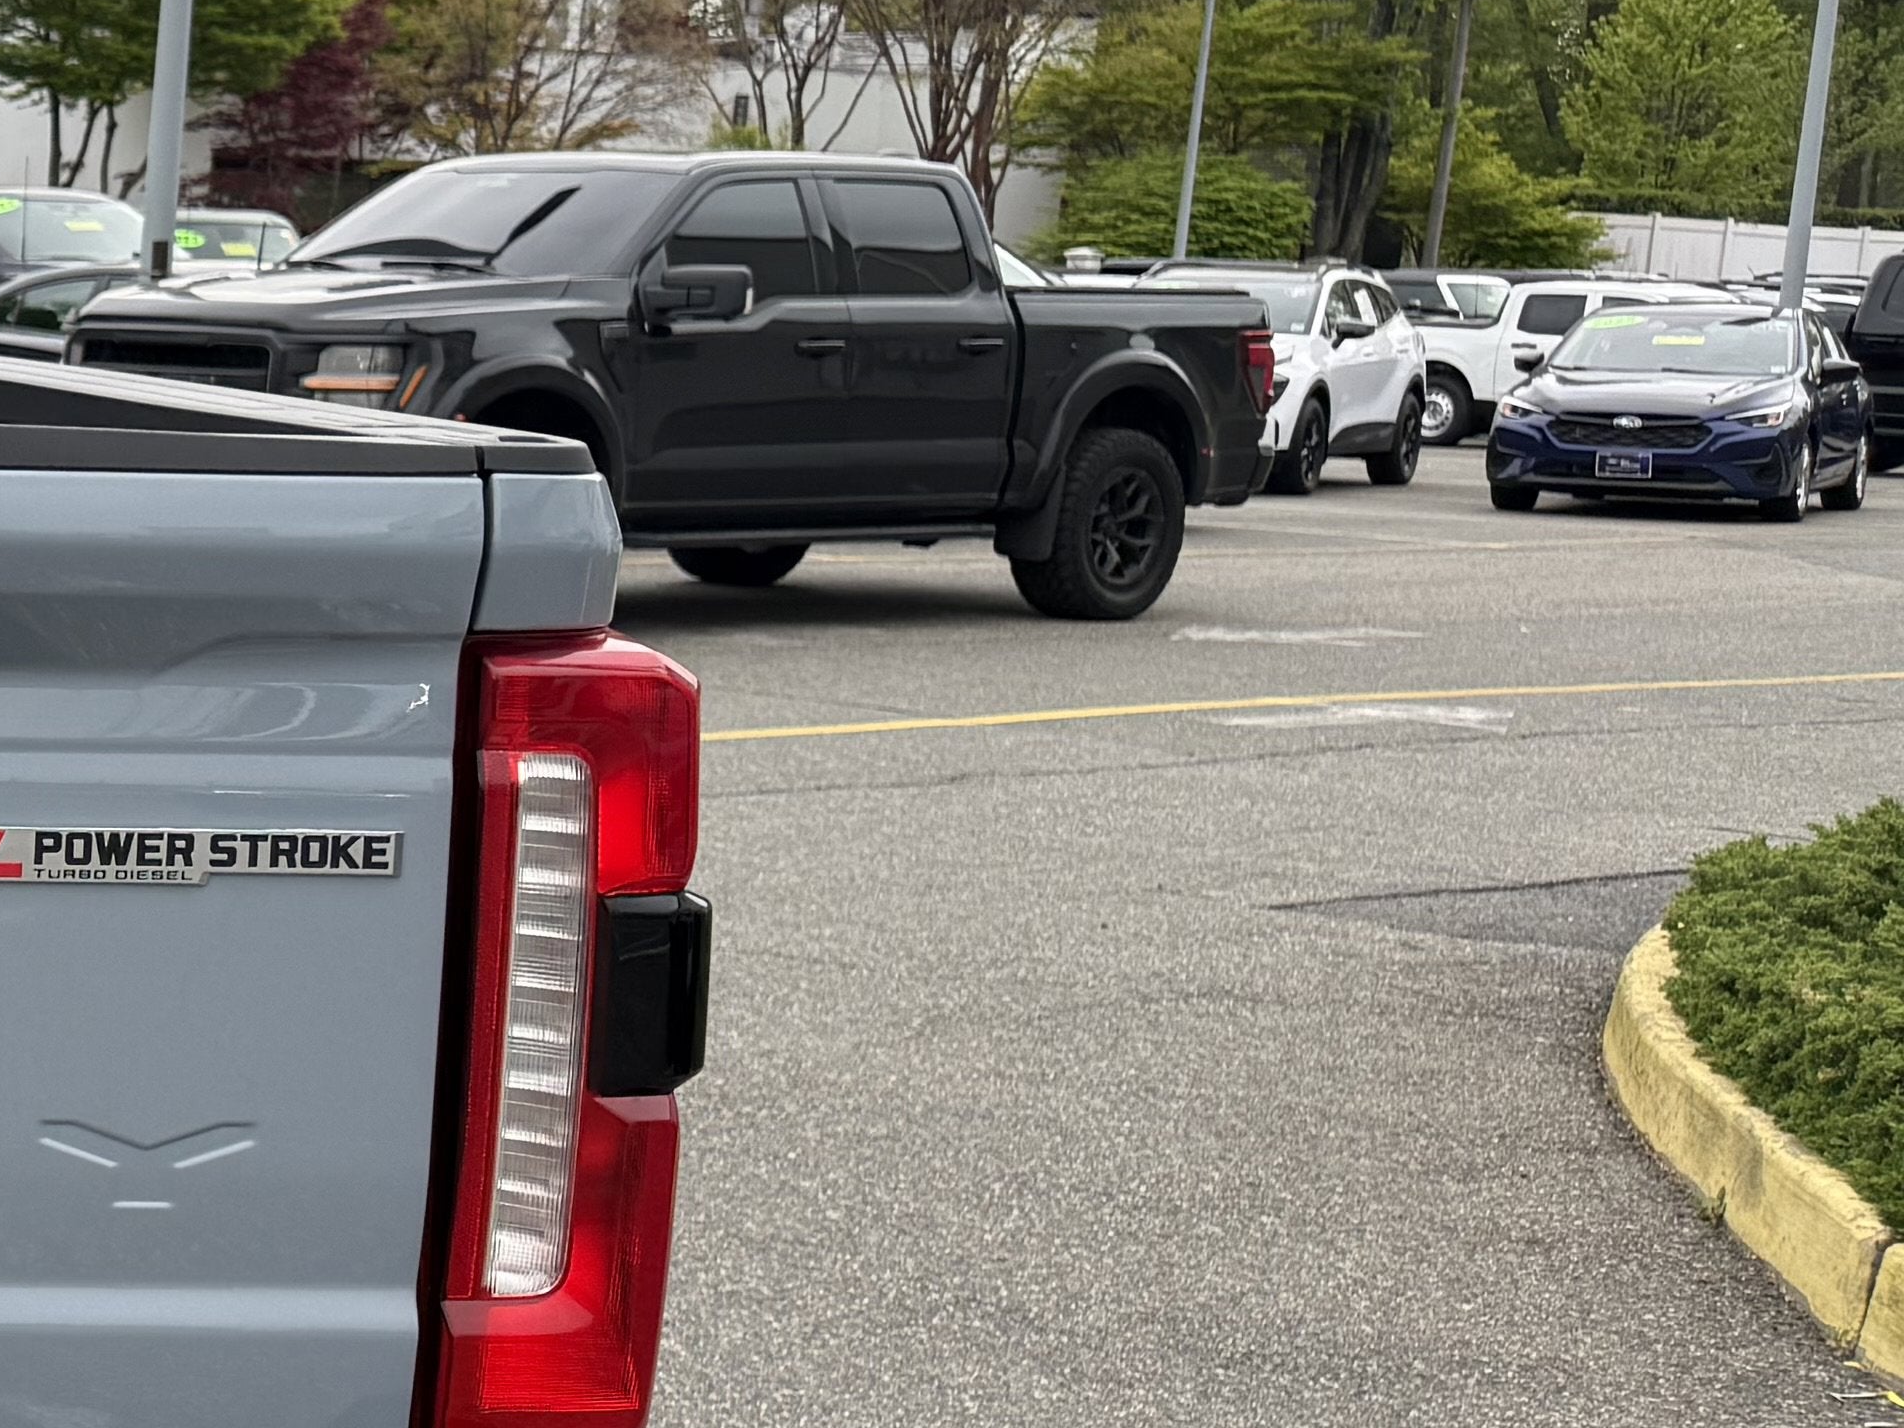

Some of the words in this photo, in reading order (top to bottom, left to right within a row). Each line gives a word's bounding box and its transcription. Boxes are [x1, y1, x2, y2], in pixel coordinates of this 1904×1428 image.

[33, 830, 196, 867] POWER
[208, 832, 391, 870] STROKE
[34, 868, 107, 881] TURBO
[115, 869, 194, 882] DIESEL
